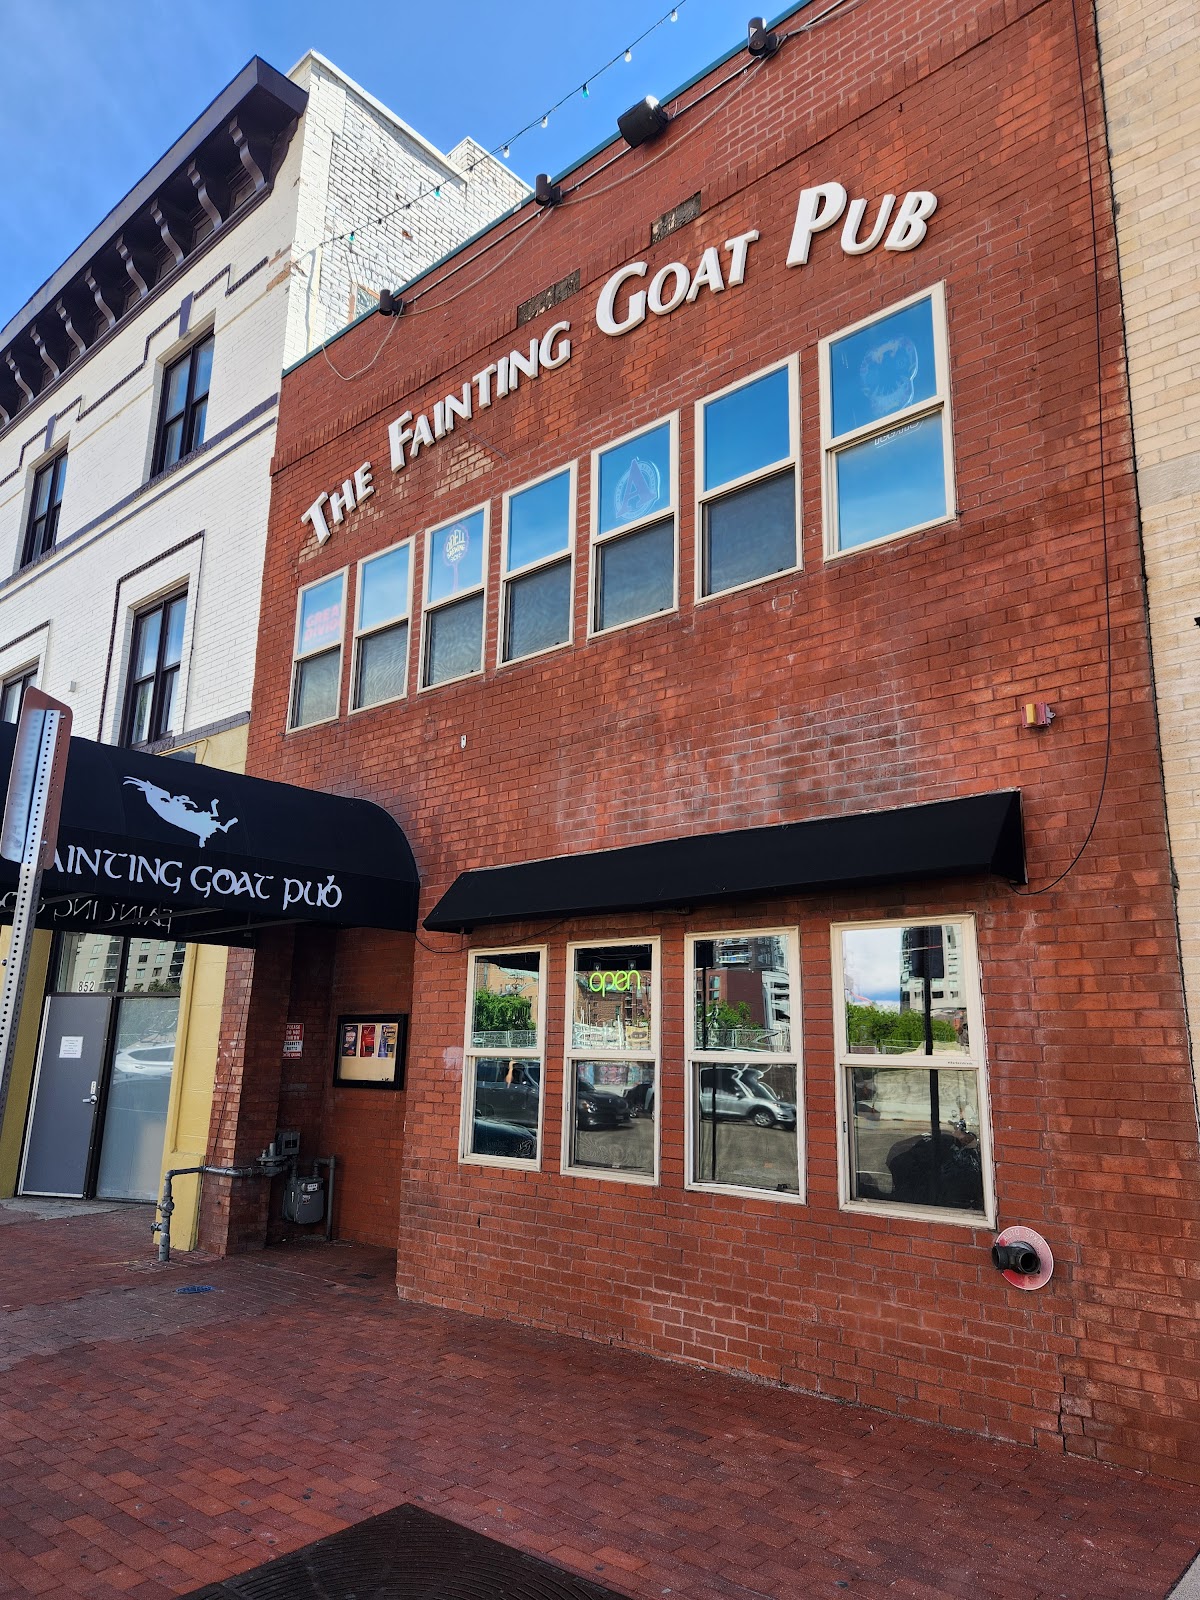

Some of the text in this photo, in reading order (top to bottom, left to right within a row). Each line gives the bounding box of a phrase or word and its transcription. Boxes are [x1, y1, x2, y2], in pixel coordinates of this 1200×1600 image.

[301, 181, 938, 547] THE FAINTING GOAT PUB
[190, 865, 274, 899] GOAT
[78, 980, 95, 992] 852
[589, 969, 641, 998] open
